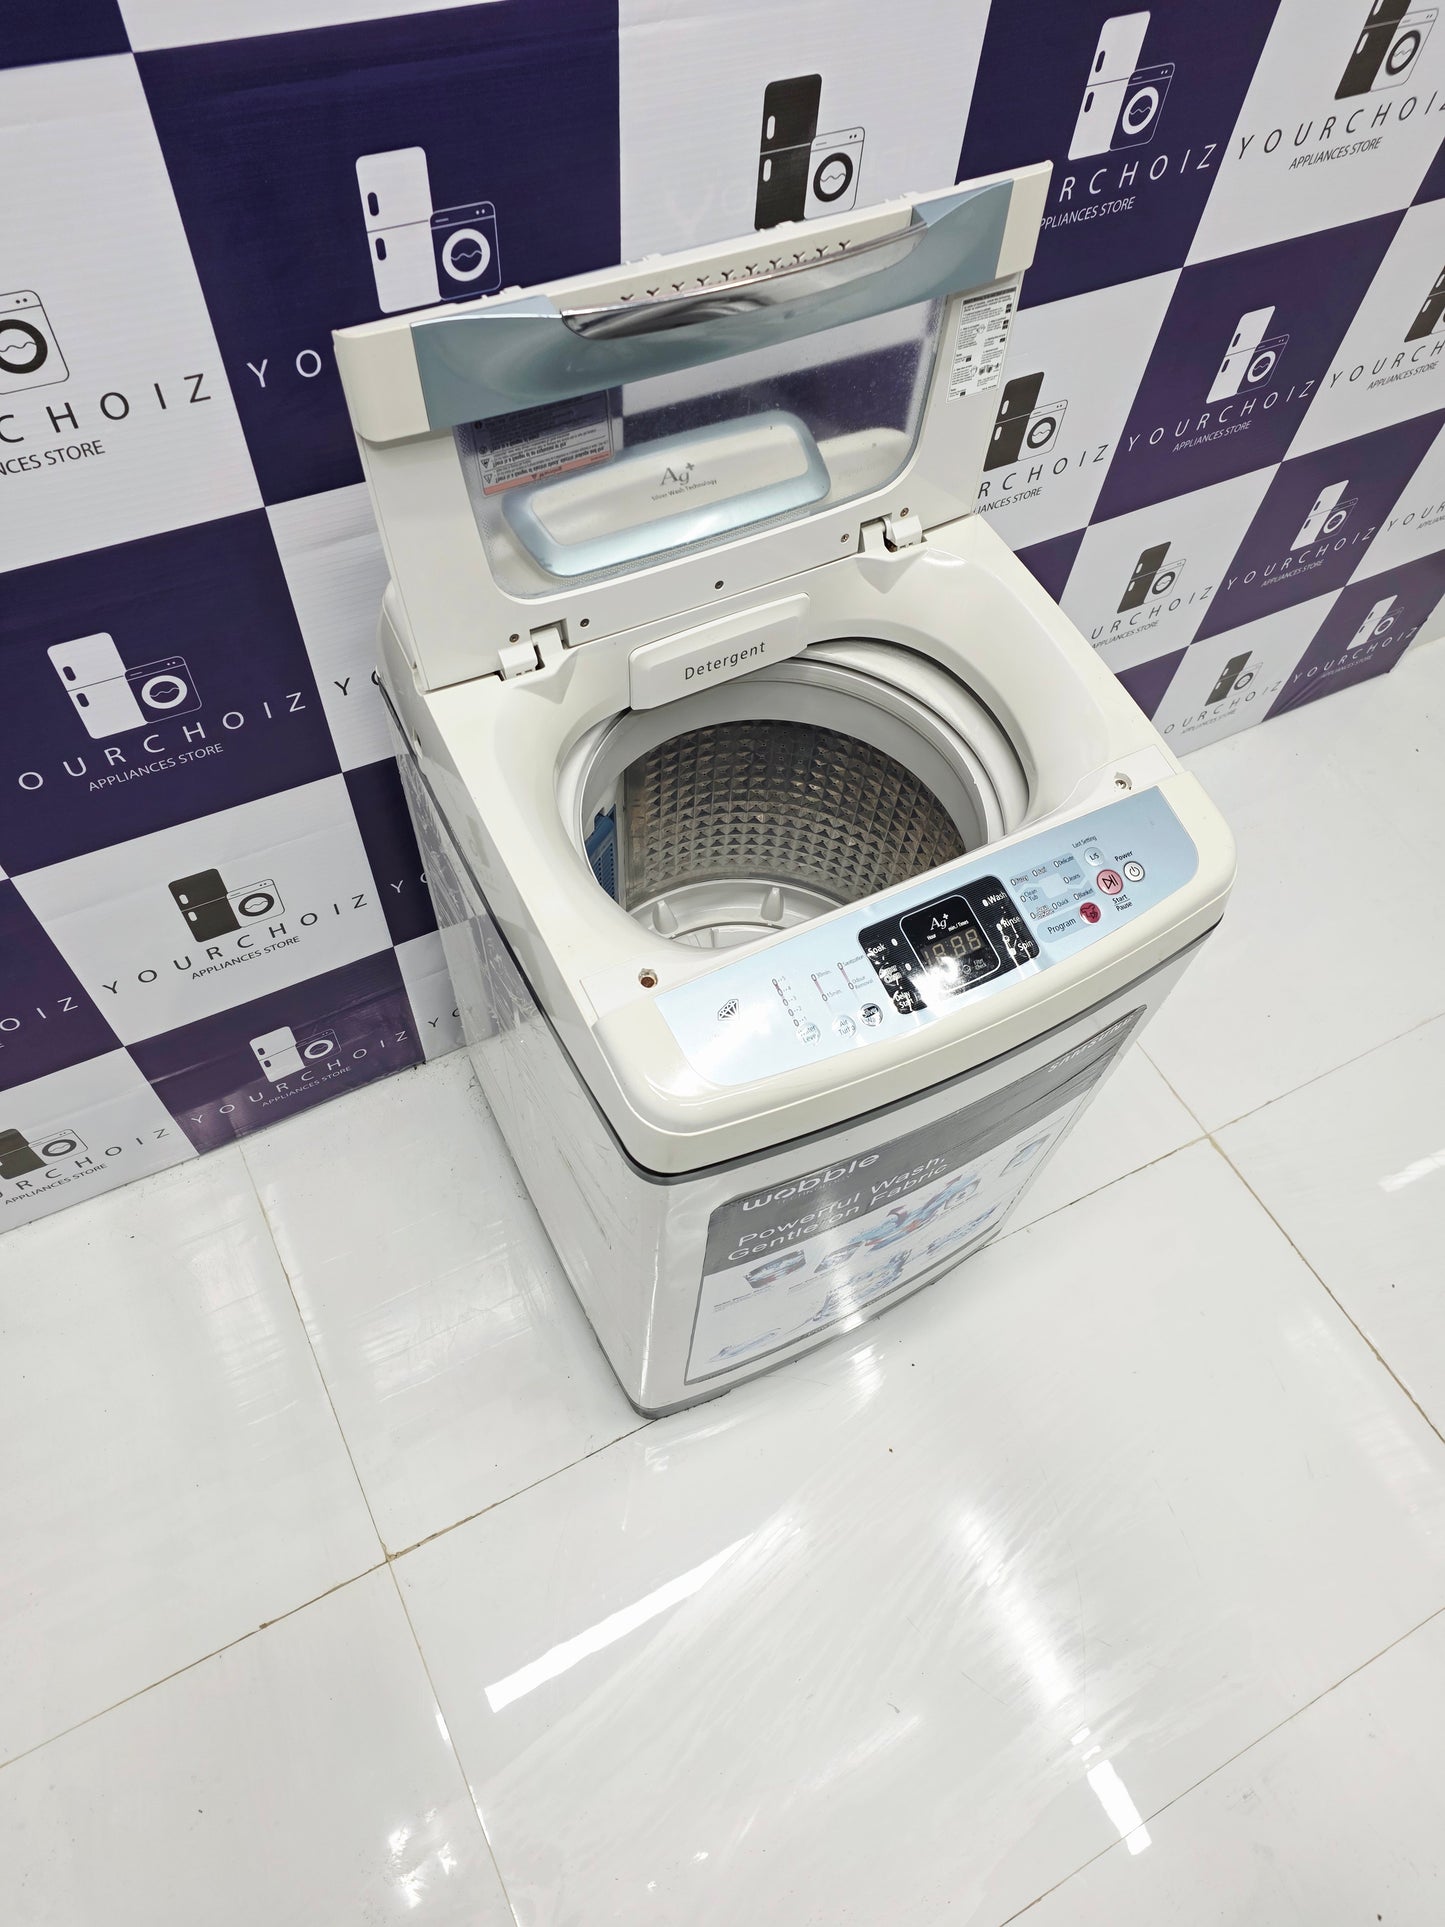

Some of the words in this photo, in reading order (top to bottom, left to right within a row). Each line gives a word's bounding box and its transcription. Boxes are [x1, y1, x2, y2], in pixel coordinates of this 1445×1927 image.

[1239, 90, 1445, 160] YOURCHOI
[1059, 143, 1217, 202] RCHOIZ
[1289, 145, 1349, 170] APPLIANCES
[1349, 137, 1383, 156] STORE
[1099, 196, 1136, 217] STORE
[246, 349, 322, 389] YO
[1366, 369, 1412, 391] APPLIANCES
[1412, 360, 1440, 376] STORE
[0, 373, 211, 443] CHOIZ
[1128, 380, 1316, 452] YOURCHOIZ
[44, 440, 106, 466] STORE
[1172, 428, 1225, 453] APPLIANCES
[1225, 420, 1253, 437] STORE
[977, 444, 1109, 500] RCHOIZ
[1011, 487, 1043, 504] STORE
[1227, 526, 1376, 590] YOURCHOIZ
[1260, 567, 1303, 588] APPLIANCES
[1302, 559, 1325, 575] STORE
[1091, 586, 1213, 640] URCHOIZ
[1135, 620, 1160, 634] STORE
[684, 641, 766, 680] Detergent
[1293, 626, 1418, 684] YOURCHOIZ
[1164, 680, 1282, 734] OURCHOIZ
[18, 692, 306, 790] OURCHOIZ
[88, 757, 176, 791] APPLIANCES
[177, 743, 224, 765] STORE
[1114, 851, 1133, 862] Power
[988, 891, 1007, 906] Wash
[1112, 894, 1128, 904] Start
[1116, 901, 1133, 912] Pause
[1001, 915, 1021, 929] Rinse
[1047, 917, 1077, 935] Program
[102, 894, 368, 994] YOURCHOIZ
[191, 950, 262, 980] APPLIANCES
[263, 935, 301, 954] STORE
[868, 943, 886, 955] Soak
[1017, 940, 1033, 952] Spin
[0, 997, 78, 1031] OIZ
[191, 1030, 408, 1125] YOURCHOIZ
[262, 1079, 320, 1108] APPLIANCES
[320, 1066, 351, 1086] STORE
[0, 1128, 170, 1199] RCHOIZ
[5, 1177, 71, 1205] APPLIANCES
[72, 1163, 108, 1179] STORE
[742, 1153, 880, 1212] wobble
[727, 1221, 819, 1261] Gentle
[828, 1206, 860, 1225] on
[870, 1164, 948, 1206] Fabric
[738, 1193, 861, 1247] Powerful
[871, 1157, 946, 1194] Wash,
